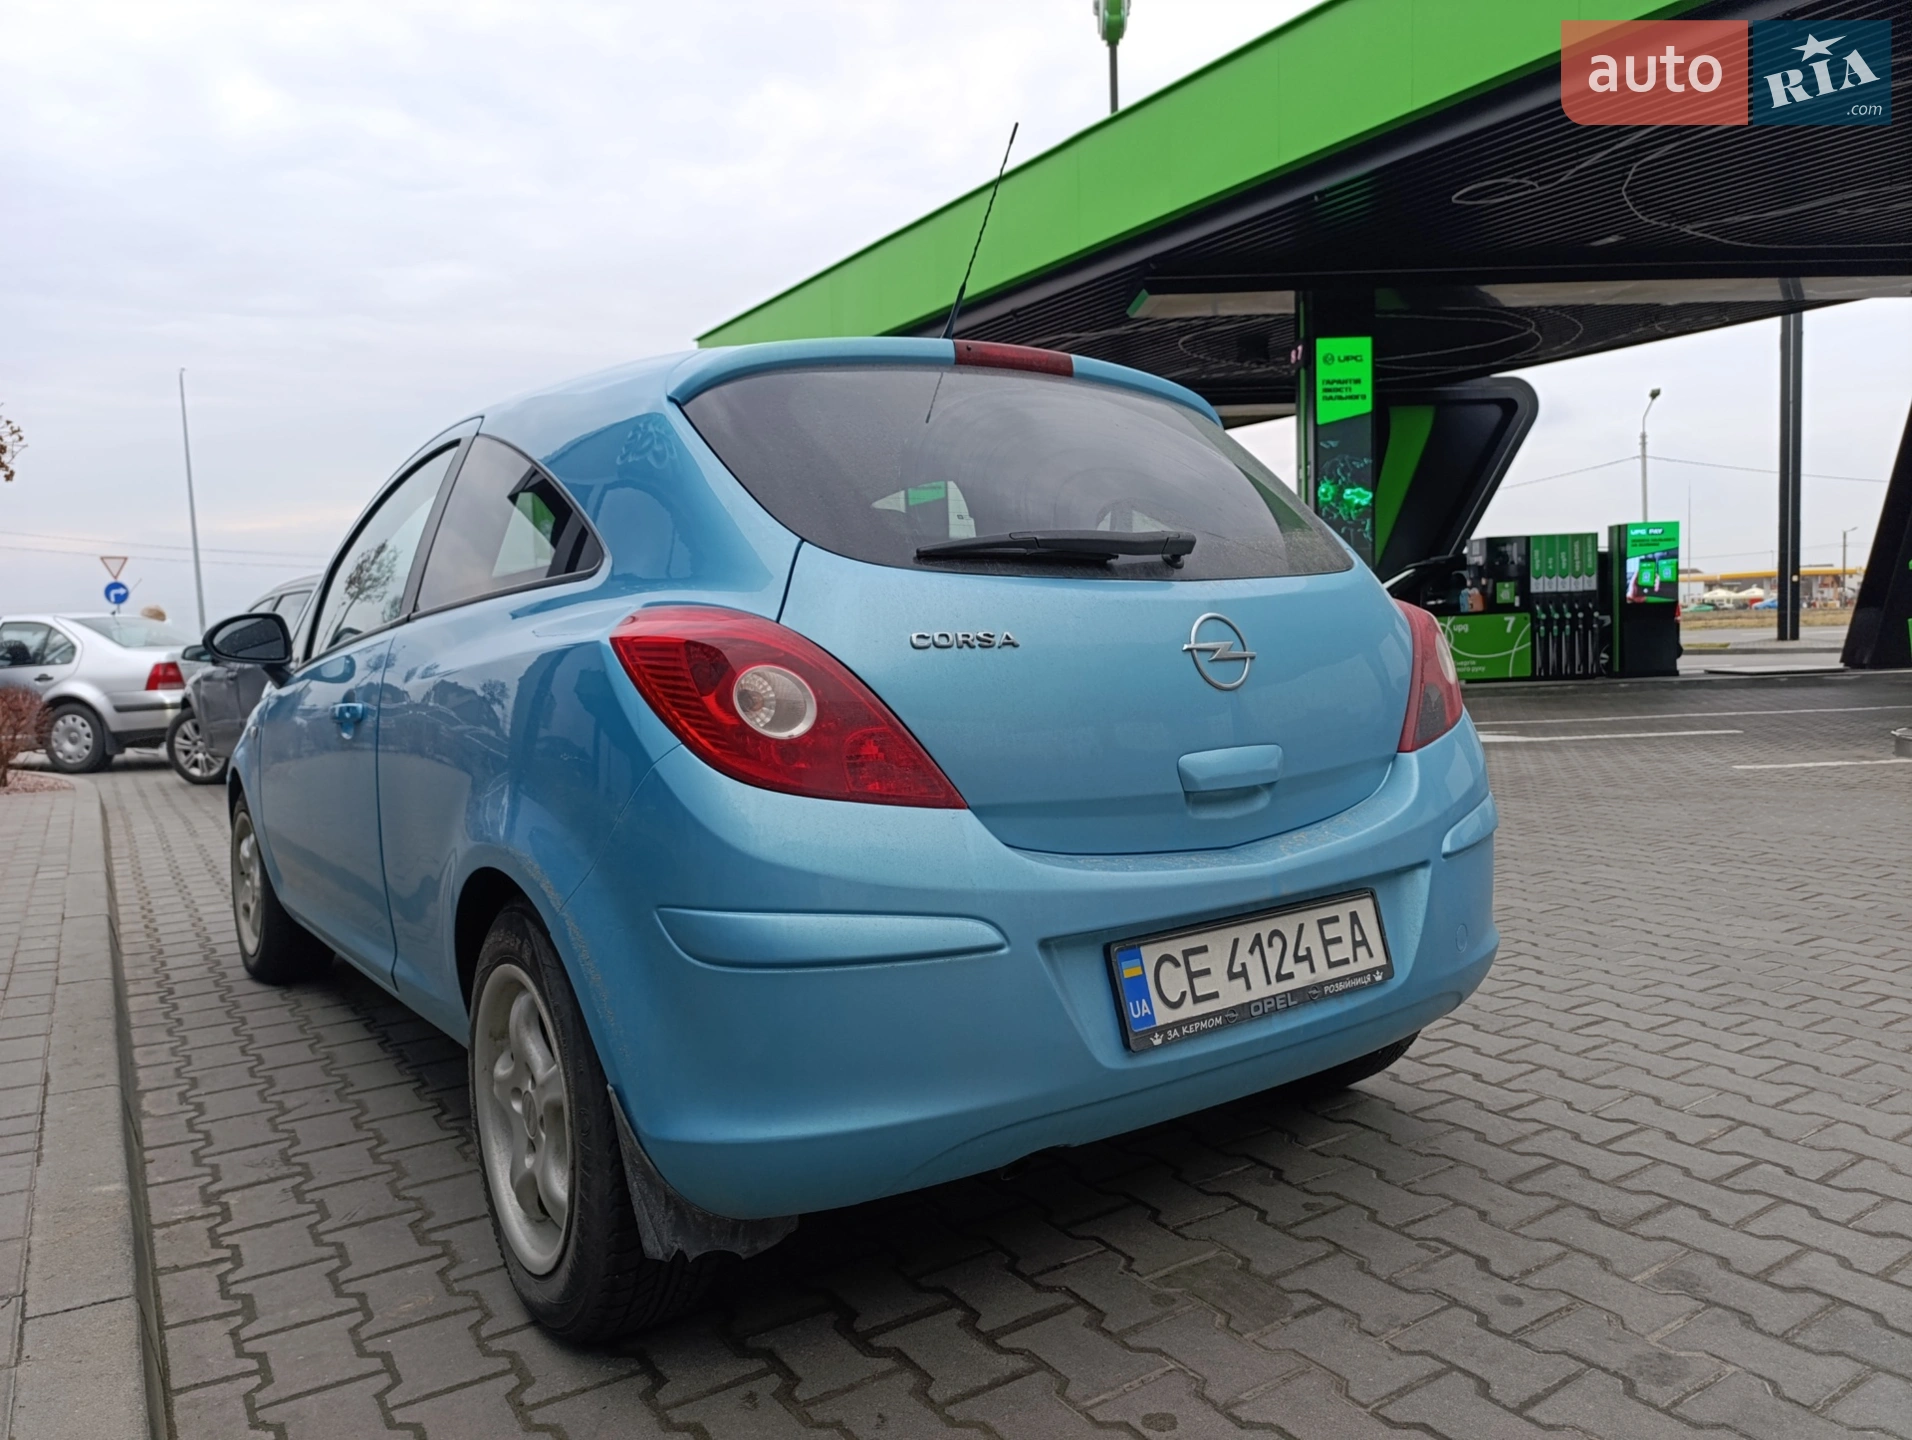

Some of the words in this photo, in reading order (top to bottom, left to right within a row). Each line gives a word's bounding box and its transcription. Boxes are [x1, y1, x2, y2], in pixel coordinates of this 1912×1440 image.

[1337, 355, 1364, 363] UPG
[1453, 623, 1469, 634] upg
[1504, 616, 1516, 633] 7
[910, 631, 1020, 650] CORSA
[1153, 944, 1220, 1010] CE
[1226, 922, 1316, 991] 4124
[1316, 910, 1374, 970] EA
[1130, 998, 1151, 1020] UA
[1250, 993, 1298, 1018] OPEL
[1166, 1028, 1180, 1041] ЗА
[1182, 1015, 1223, 1036] КЕРМОМ
